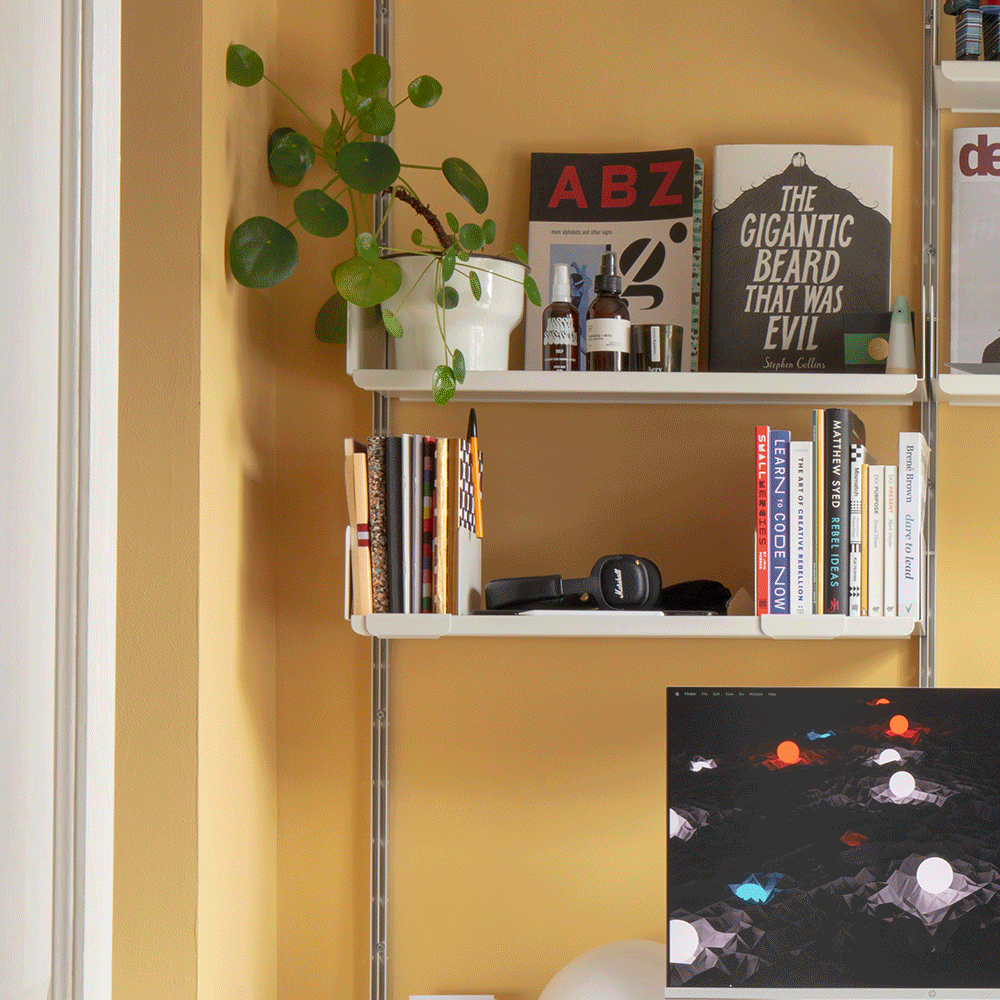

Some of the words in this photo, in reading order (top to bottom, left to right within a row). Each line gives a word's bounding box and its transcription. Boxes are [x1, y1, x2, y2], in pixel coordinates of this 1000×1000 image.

[781, 184, 819, 212] THE
[740, 213, 855, 248] GIGANTIC
[752, 249, 841, 284] BEARD
[744, 284, 802, 314] THAT
[803, 284, 844, 314] WAS
[763, 315, 820, 352] EVIL
[763, 356, 794, 371] Stephen
[796, 356, 826, 370] Collins
[758, 434, 767, 479] SMALL
[832, 420, 842, 476] MATTHEW
[905, 445, 915, 471] Brené
[774, 439, 786, 494] LEARN
[797, 495, 804, 506] OF
[831, 480, 841, 508] SYED
[905, 473, 915, 503] Brown
[758, 480, 767, 546] MERCIES
[904, 514, 915, 541] dare
[774, 512, 786, 558] CODE
[830, 517, 841, 549] REBEL
[904, 542, 913, 554] to
[830, 553, 840, 588] IDEAS
[904, 556, 915, 580] lead
[774, 565, 786, 610] NOW
